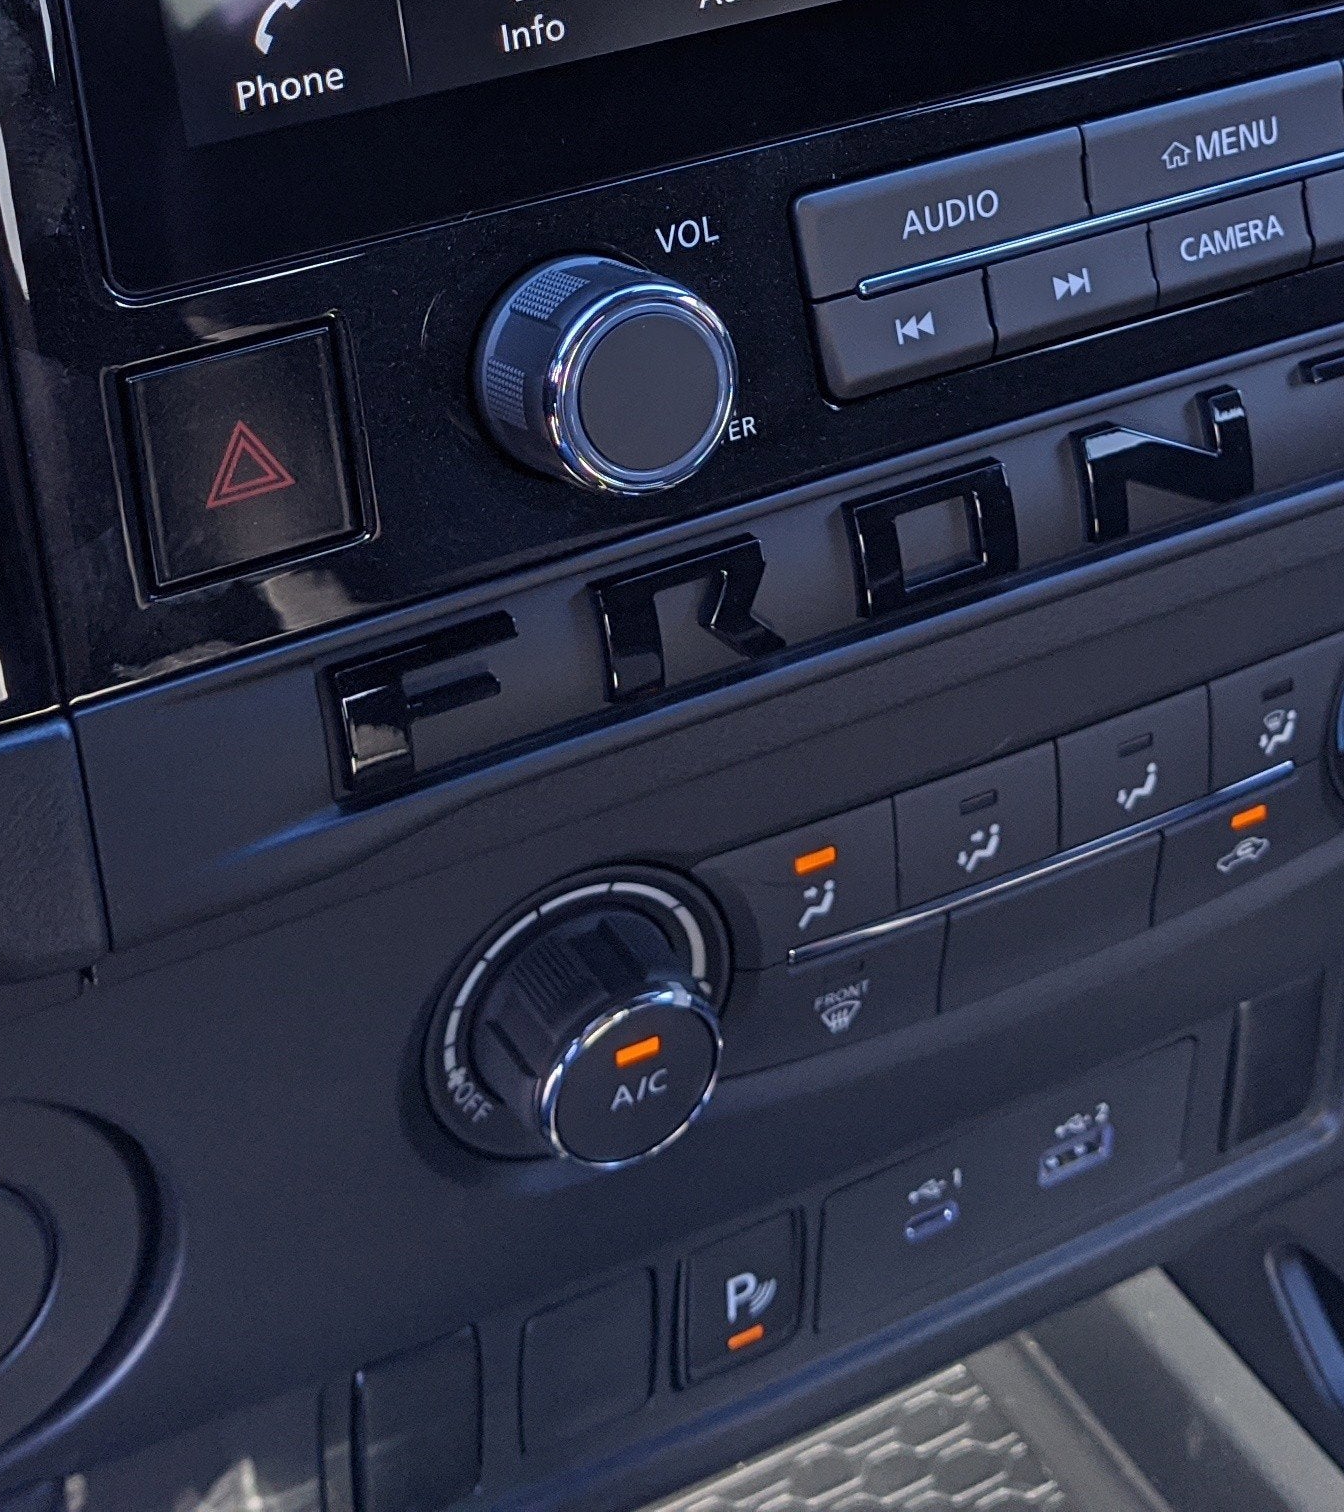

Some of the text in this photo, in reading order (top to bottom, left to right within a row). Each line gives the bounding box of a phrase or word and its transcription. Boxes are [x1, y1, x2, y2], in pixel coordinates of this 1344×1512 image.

[501, 14, 565, 53] Info
[236, 67, 344, 111] Phone
[1195, 116, 1278, 163] MENU
[655, 216, 720, 253] VOL
[902, 189, 999, 240] AUDIO
[1179, 215, 1284, 263] CAMERA
[610, 1068, 668, 1111] A/C
